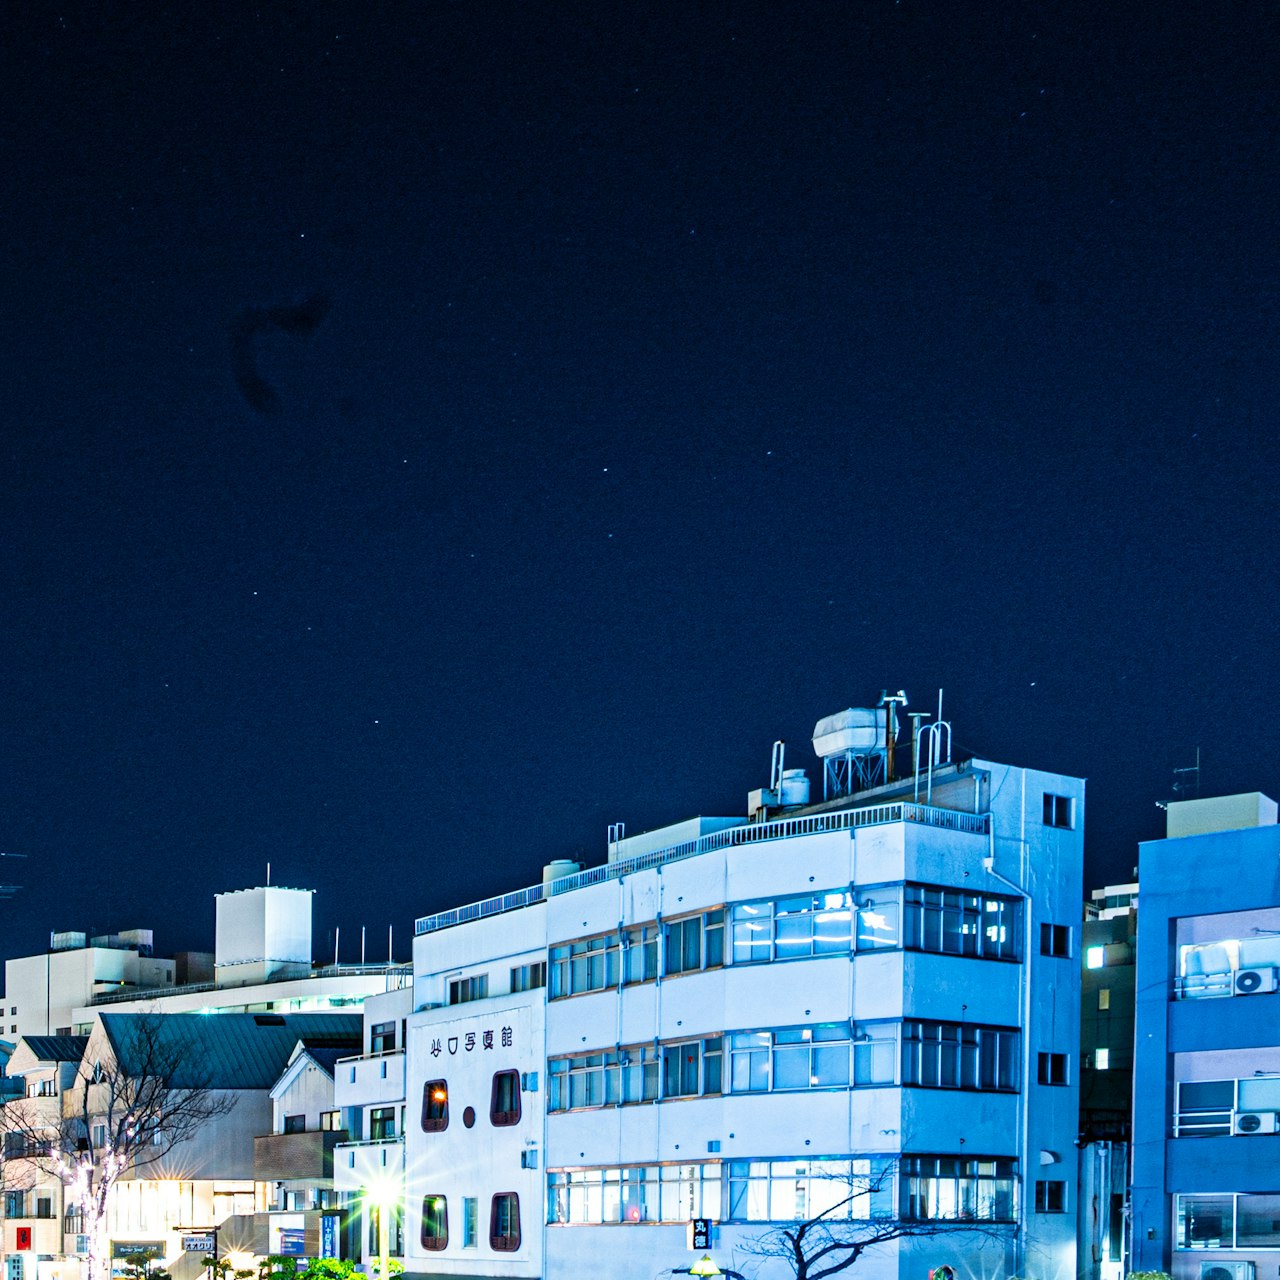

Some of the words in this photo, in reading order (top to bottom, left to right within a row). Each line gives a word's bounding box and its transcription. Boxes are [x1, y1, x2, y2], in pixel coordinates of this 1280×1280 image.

[430, 1025, 513, 1058] 谷口写真館
